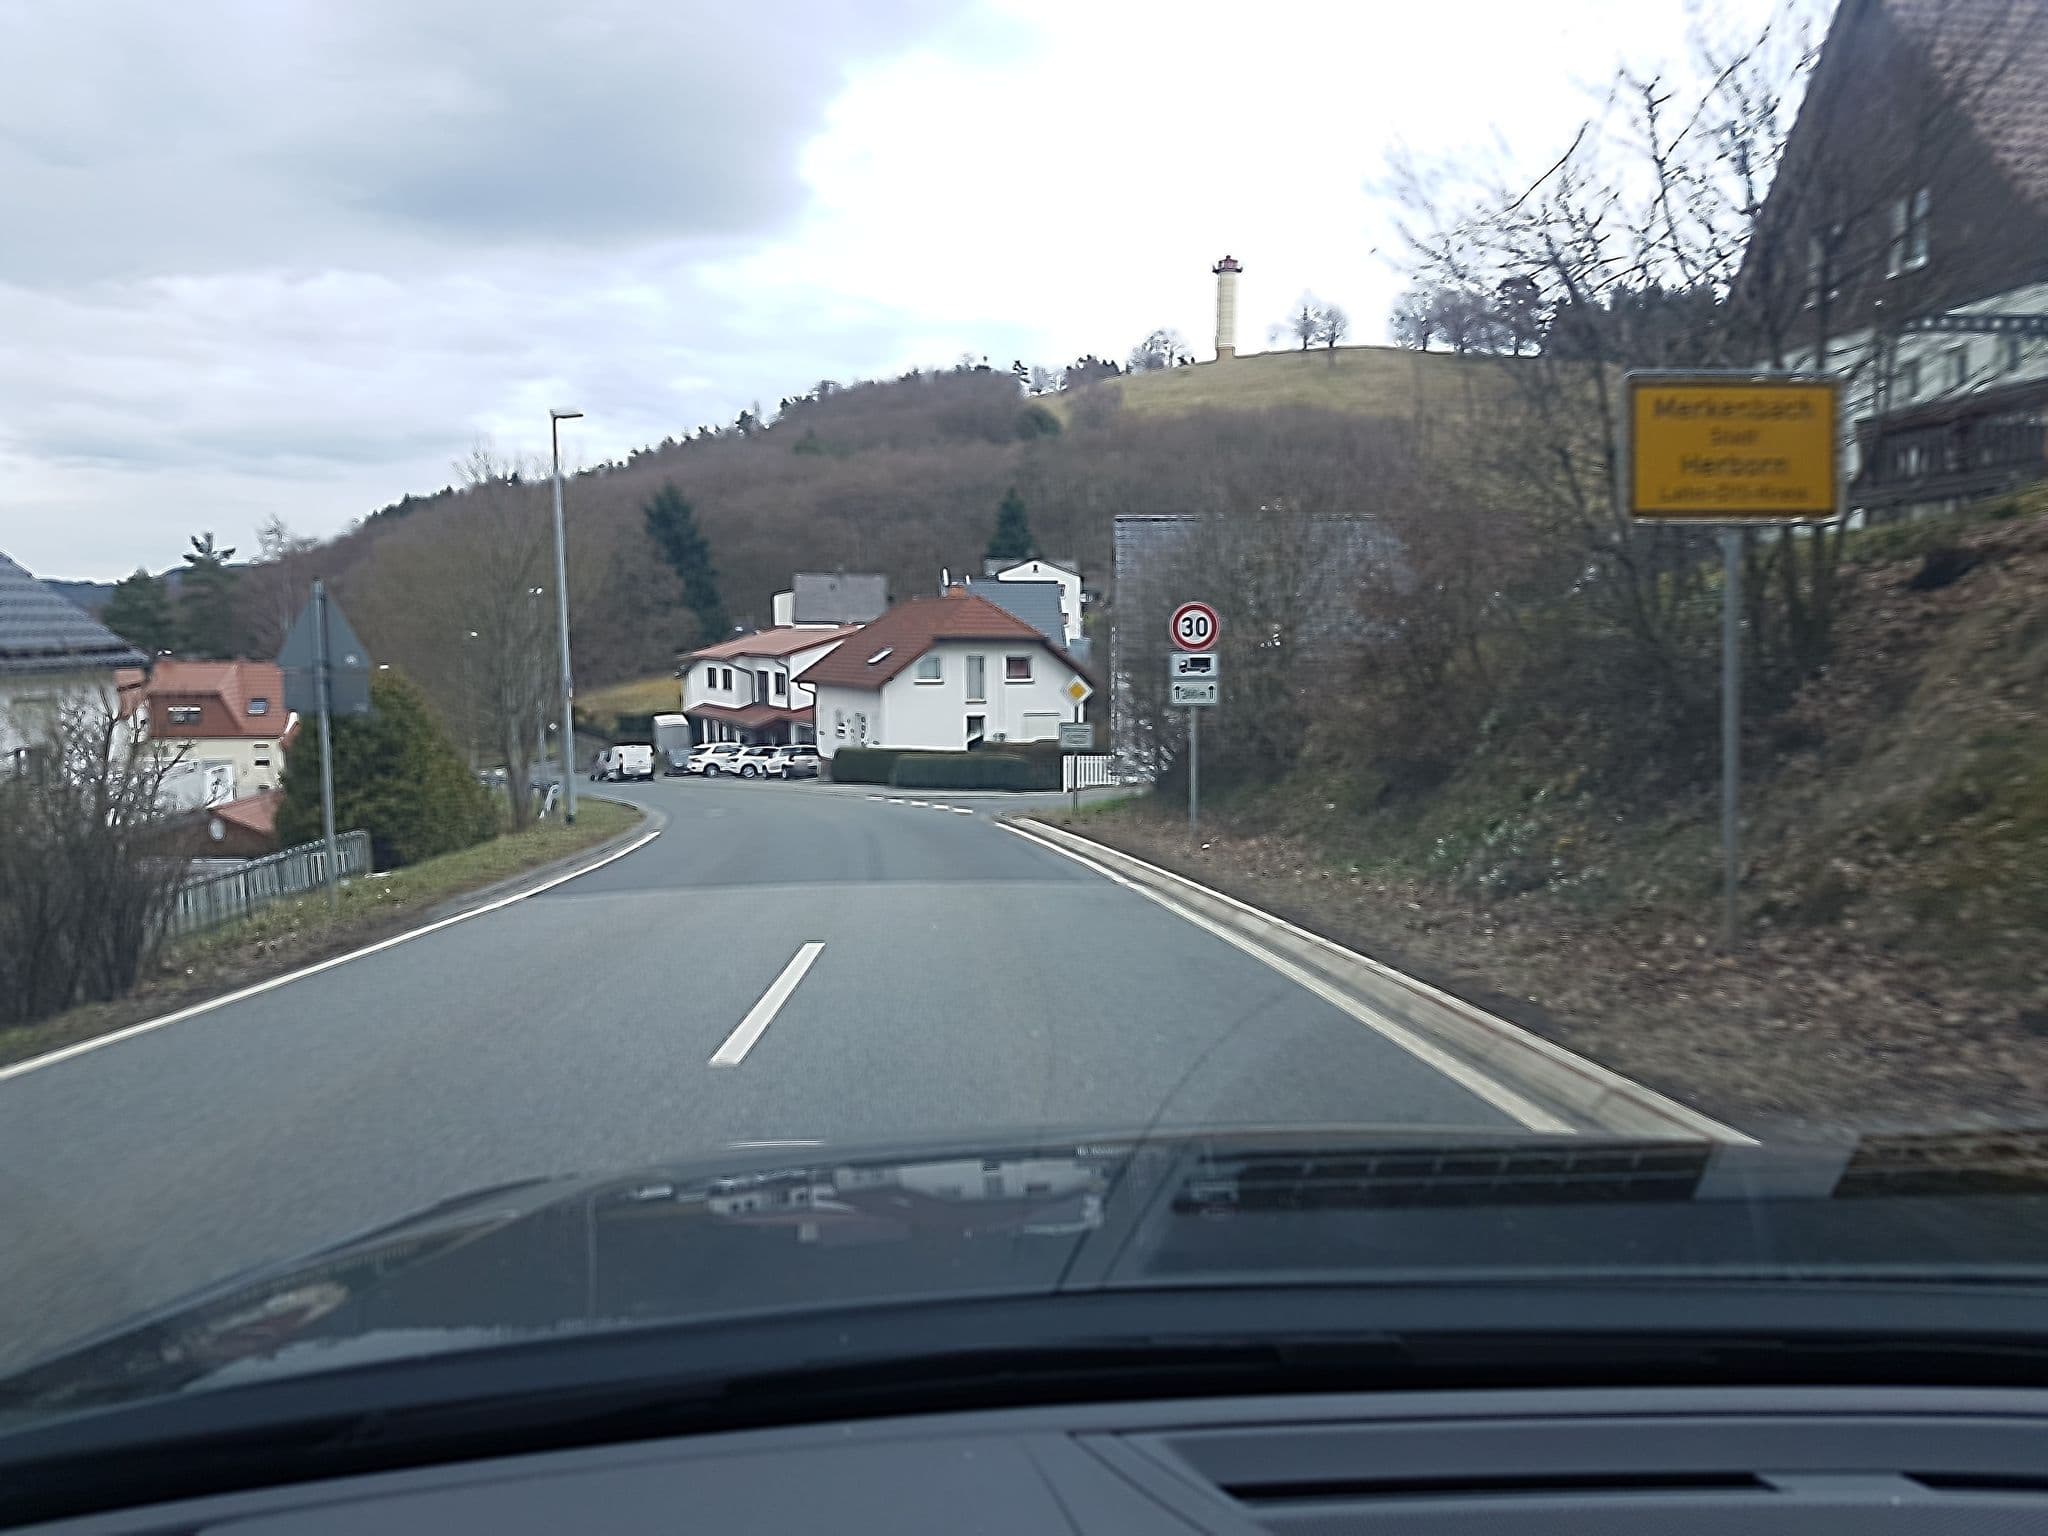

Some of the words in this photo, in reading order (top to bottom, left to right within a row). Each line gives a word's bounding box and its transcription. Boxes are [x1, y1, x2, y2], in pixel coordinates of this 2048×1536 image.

[1654, 396, 1814, 420] Merkenbach
[1680, 454, 1788, 476] Herborn
[1181, 616, 1208, 637] 30
